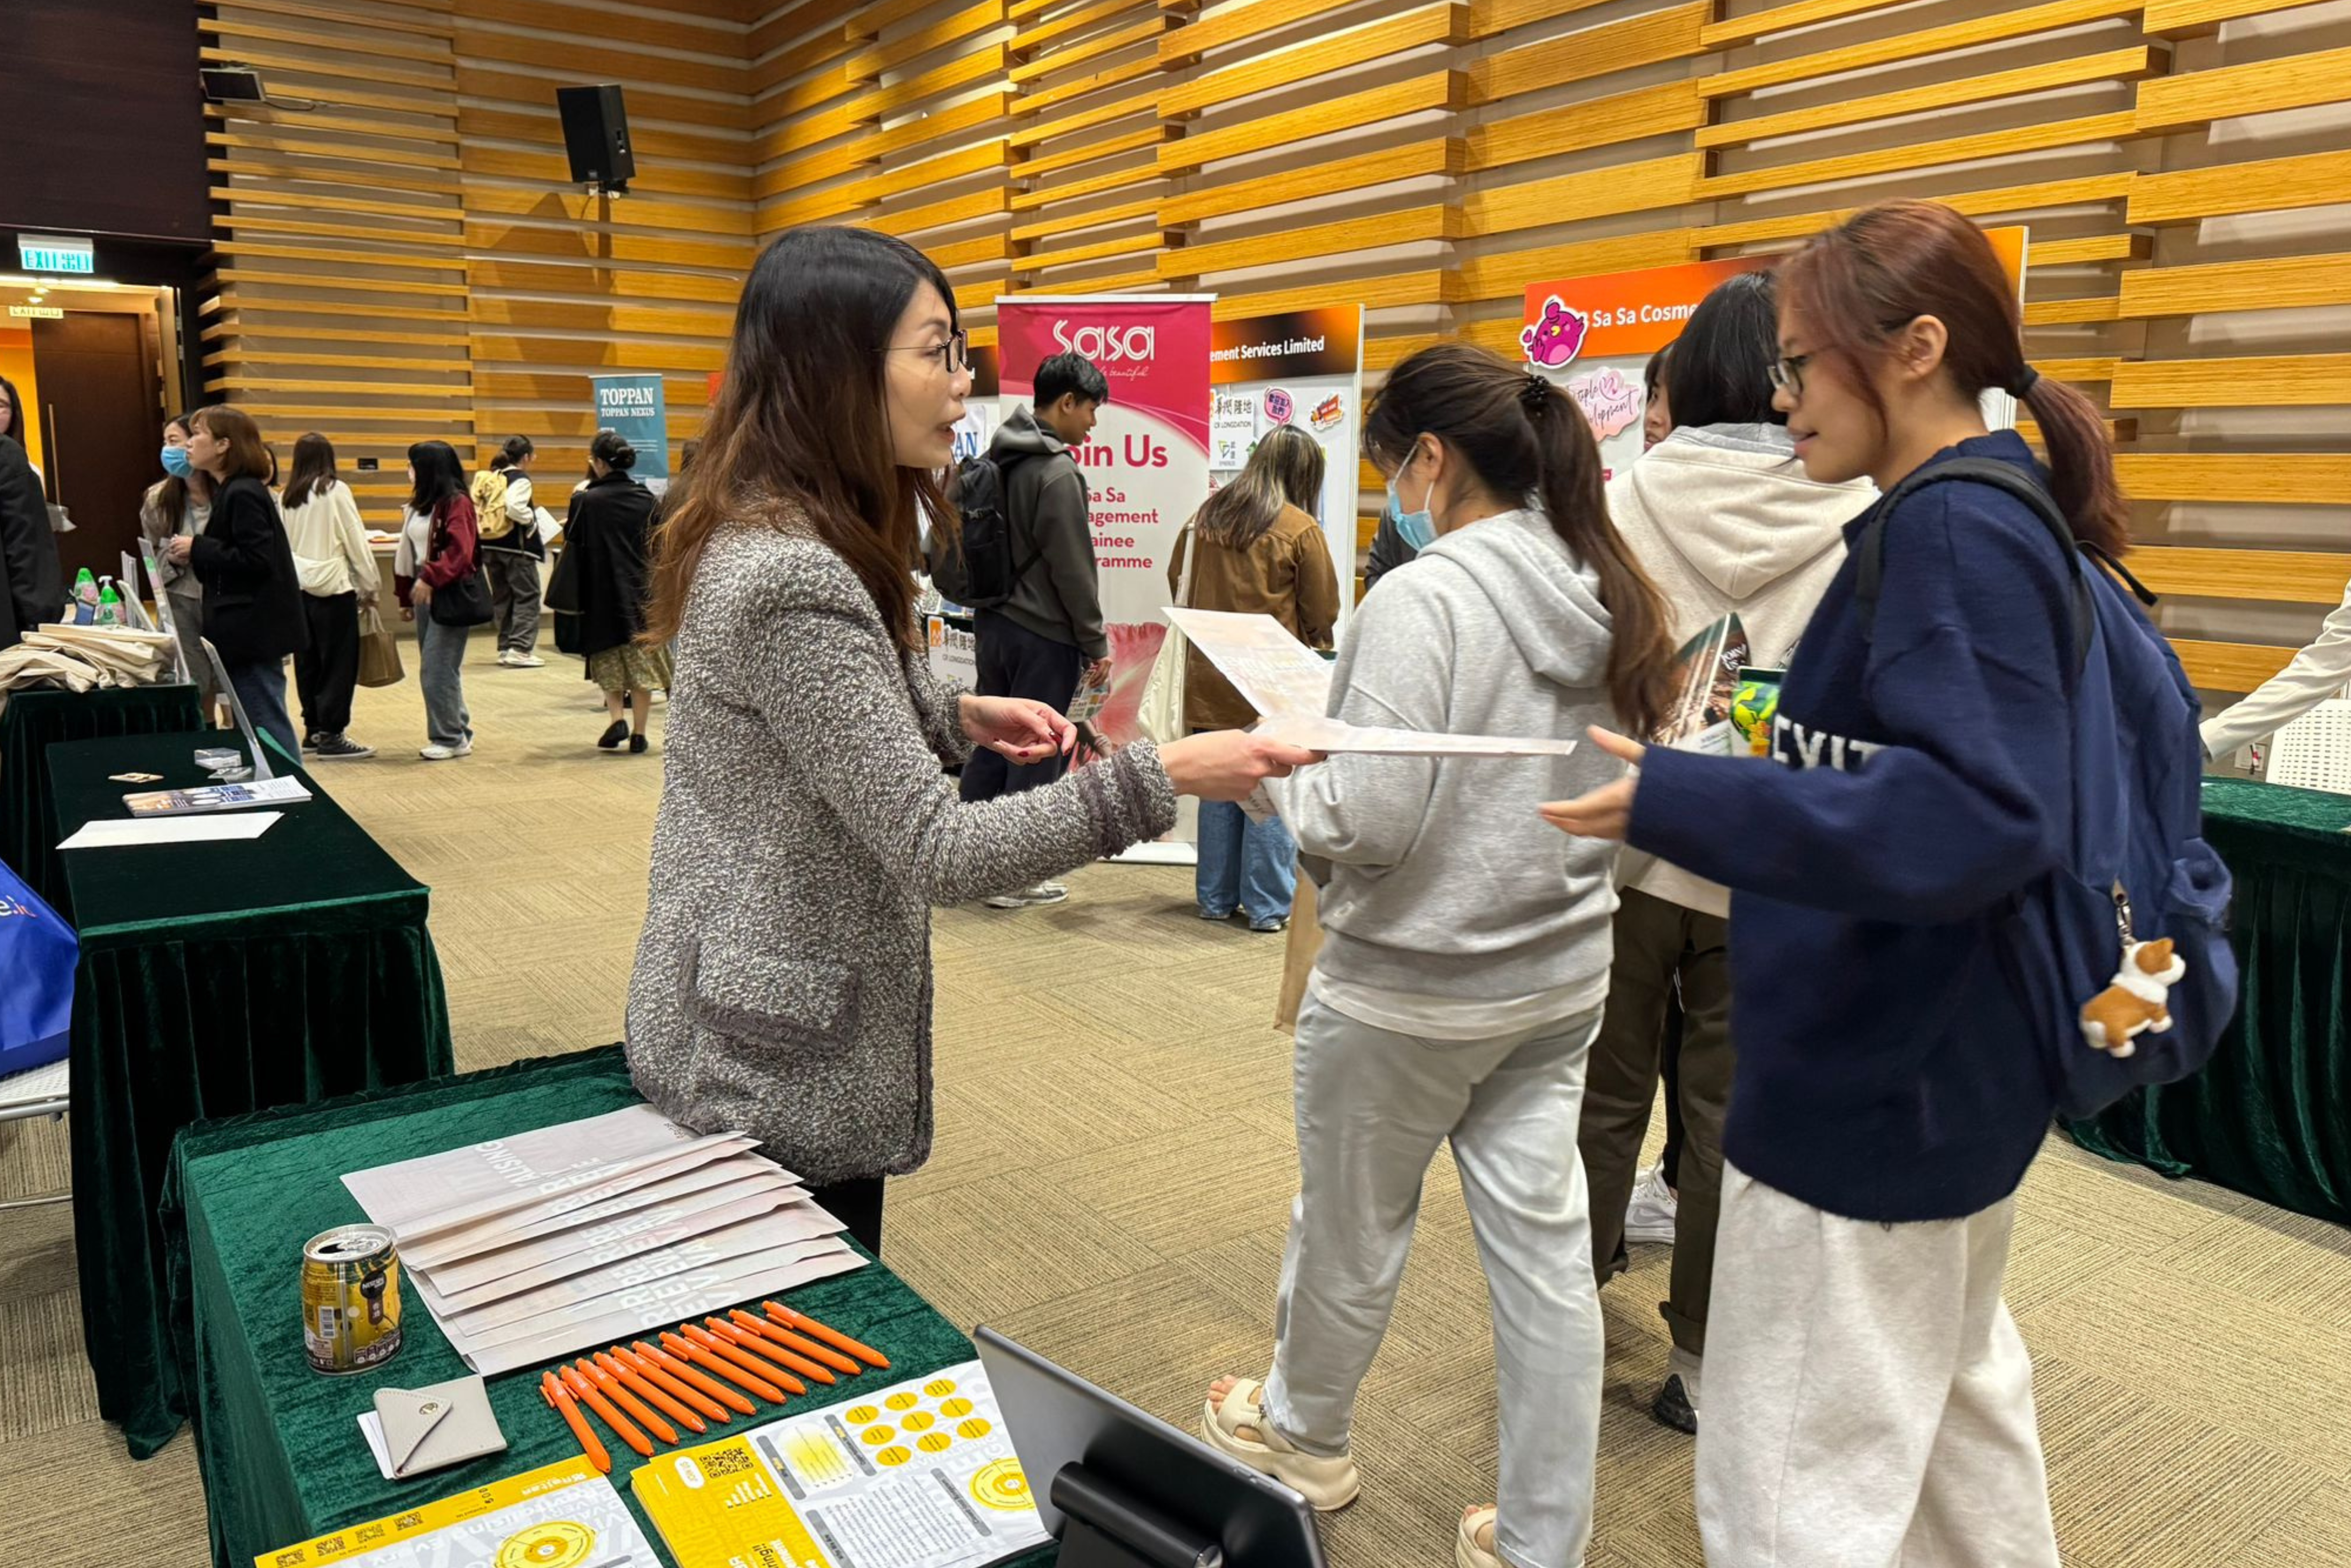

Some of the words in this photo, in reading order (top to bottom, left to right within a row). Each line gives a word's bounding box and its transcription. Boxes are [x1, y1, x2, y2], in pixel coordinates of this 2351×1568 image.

[25, 250, 57, 268] EXIT
[61, 252, 89, 271] 出口
[1592, 310, 1611, 327] Sa
[1616, 308, 1636, 325] Sa
[1053, 320, 1155, 361] Sasa
[1210, 346, 1240, 362] ement
[1241, 343, 1282, 359] Services
[1283, 336, 1325, 355] Limited
[600, 388, 654, 405] TOPPAN
[601, 407, 629, 417] TOPPAN
[631, 407, 655, 417] NEXUS
[955, 431, 978, 458] AN
[1072, 435, 1113, 467] oin
[1125, 435, 1168, 467] Us
[1106, 488, 1126, 502] Sa
[1087, 509, 1158, 527] agement
[1091, 534, 1134, 548] ainee
[1096, 557, 1153, 568] ramme
[751, 1543, 778, 1568] ring!!
